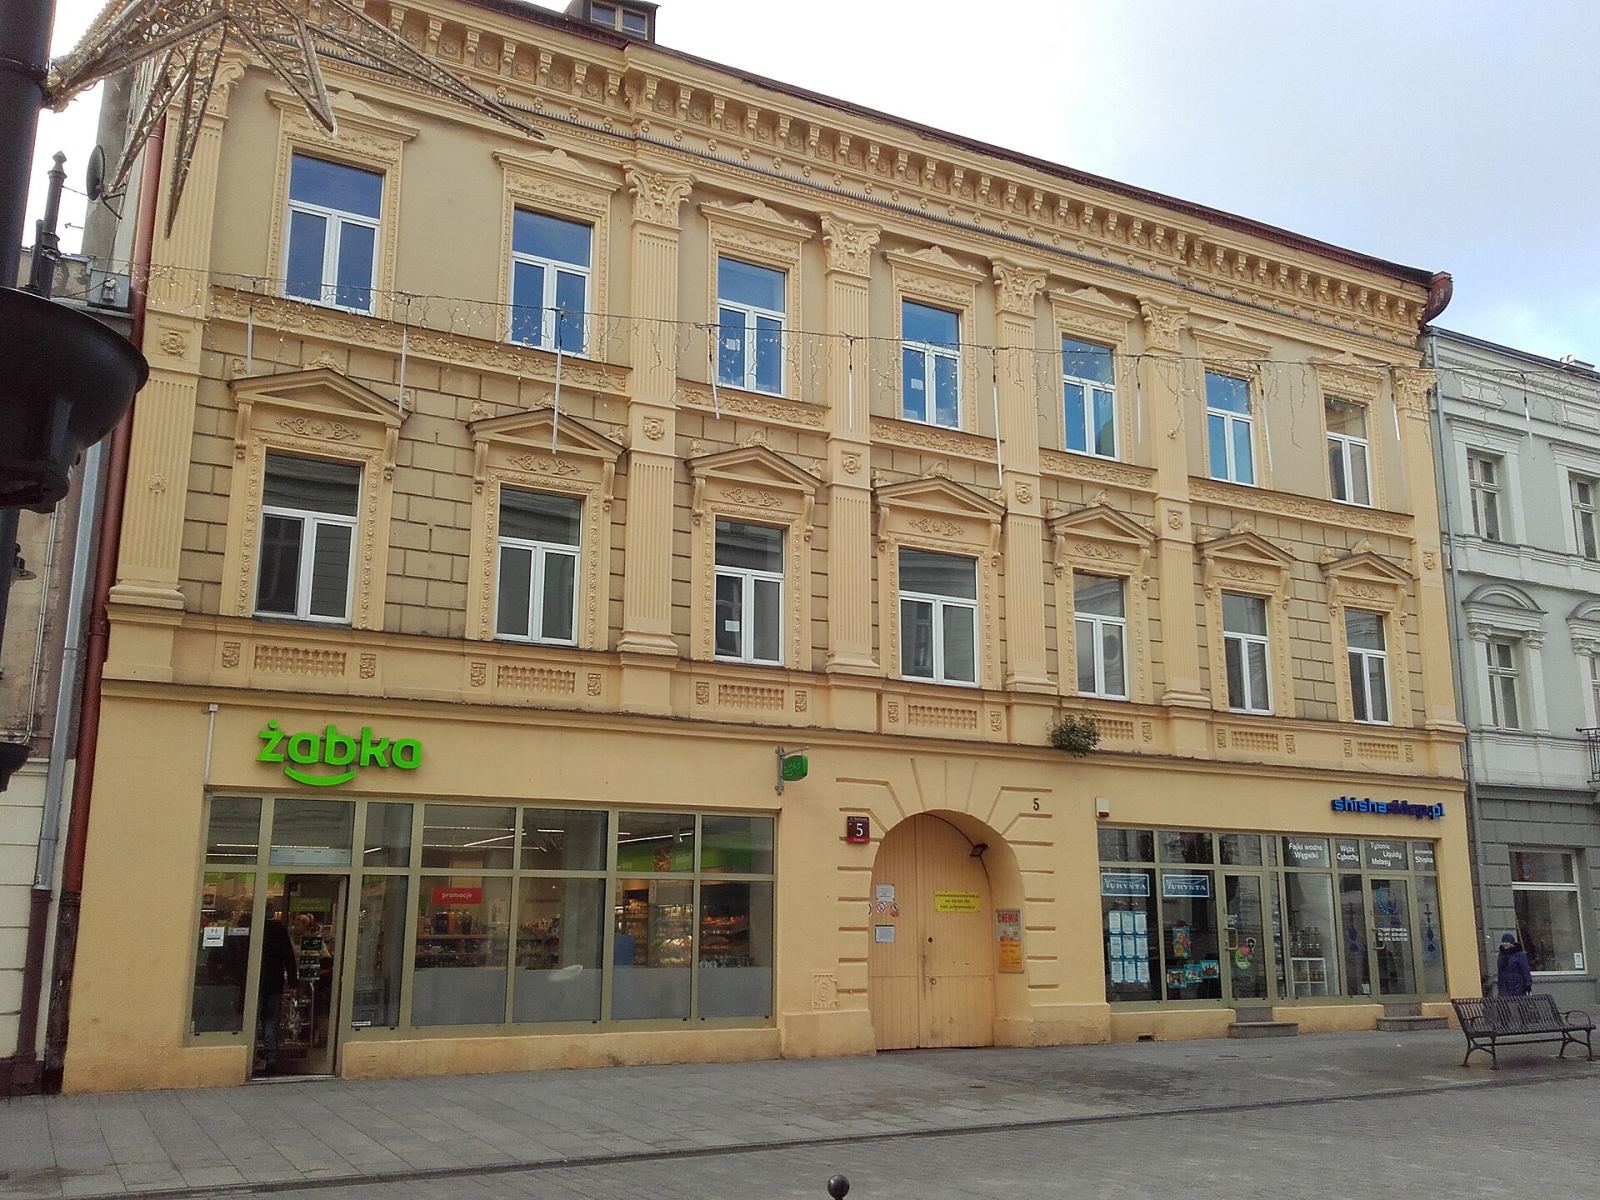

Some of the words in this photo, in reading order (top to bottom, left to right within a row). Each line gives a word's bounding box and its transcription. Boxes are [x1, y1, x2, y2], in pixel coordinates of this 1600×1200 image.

[256, 720, 422, 769] żabka
[1033, 798, 1040, 811] 5
[856, 823, 864, 837] 5
[441, 892, 473, 900] promocje
